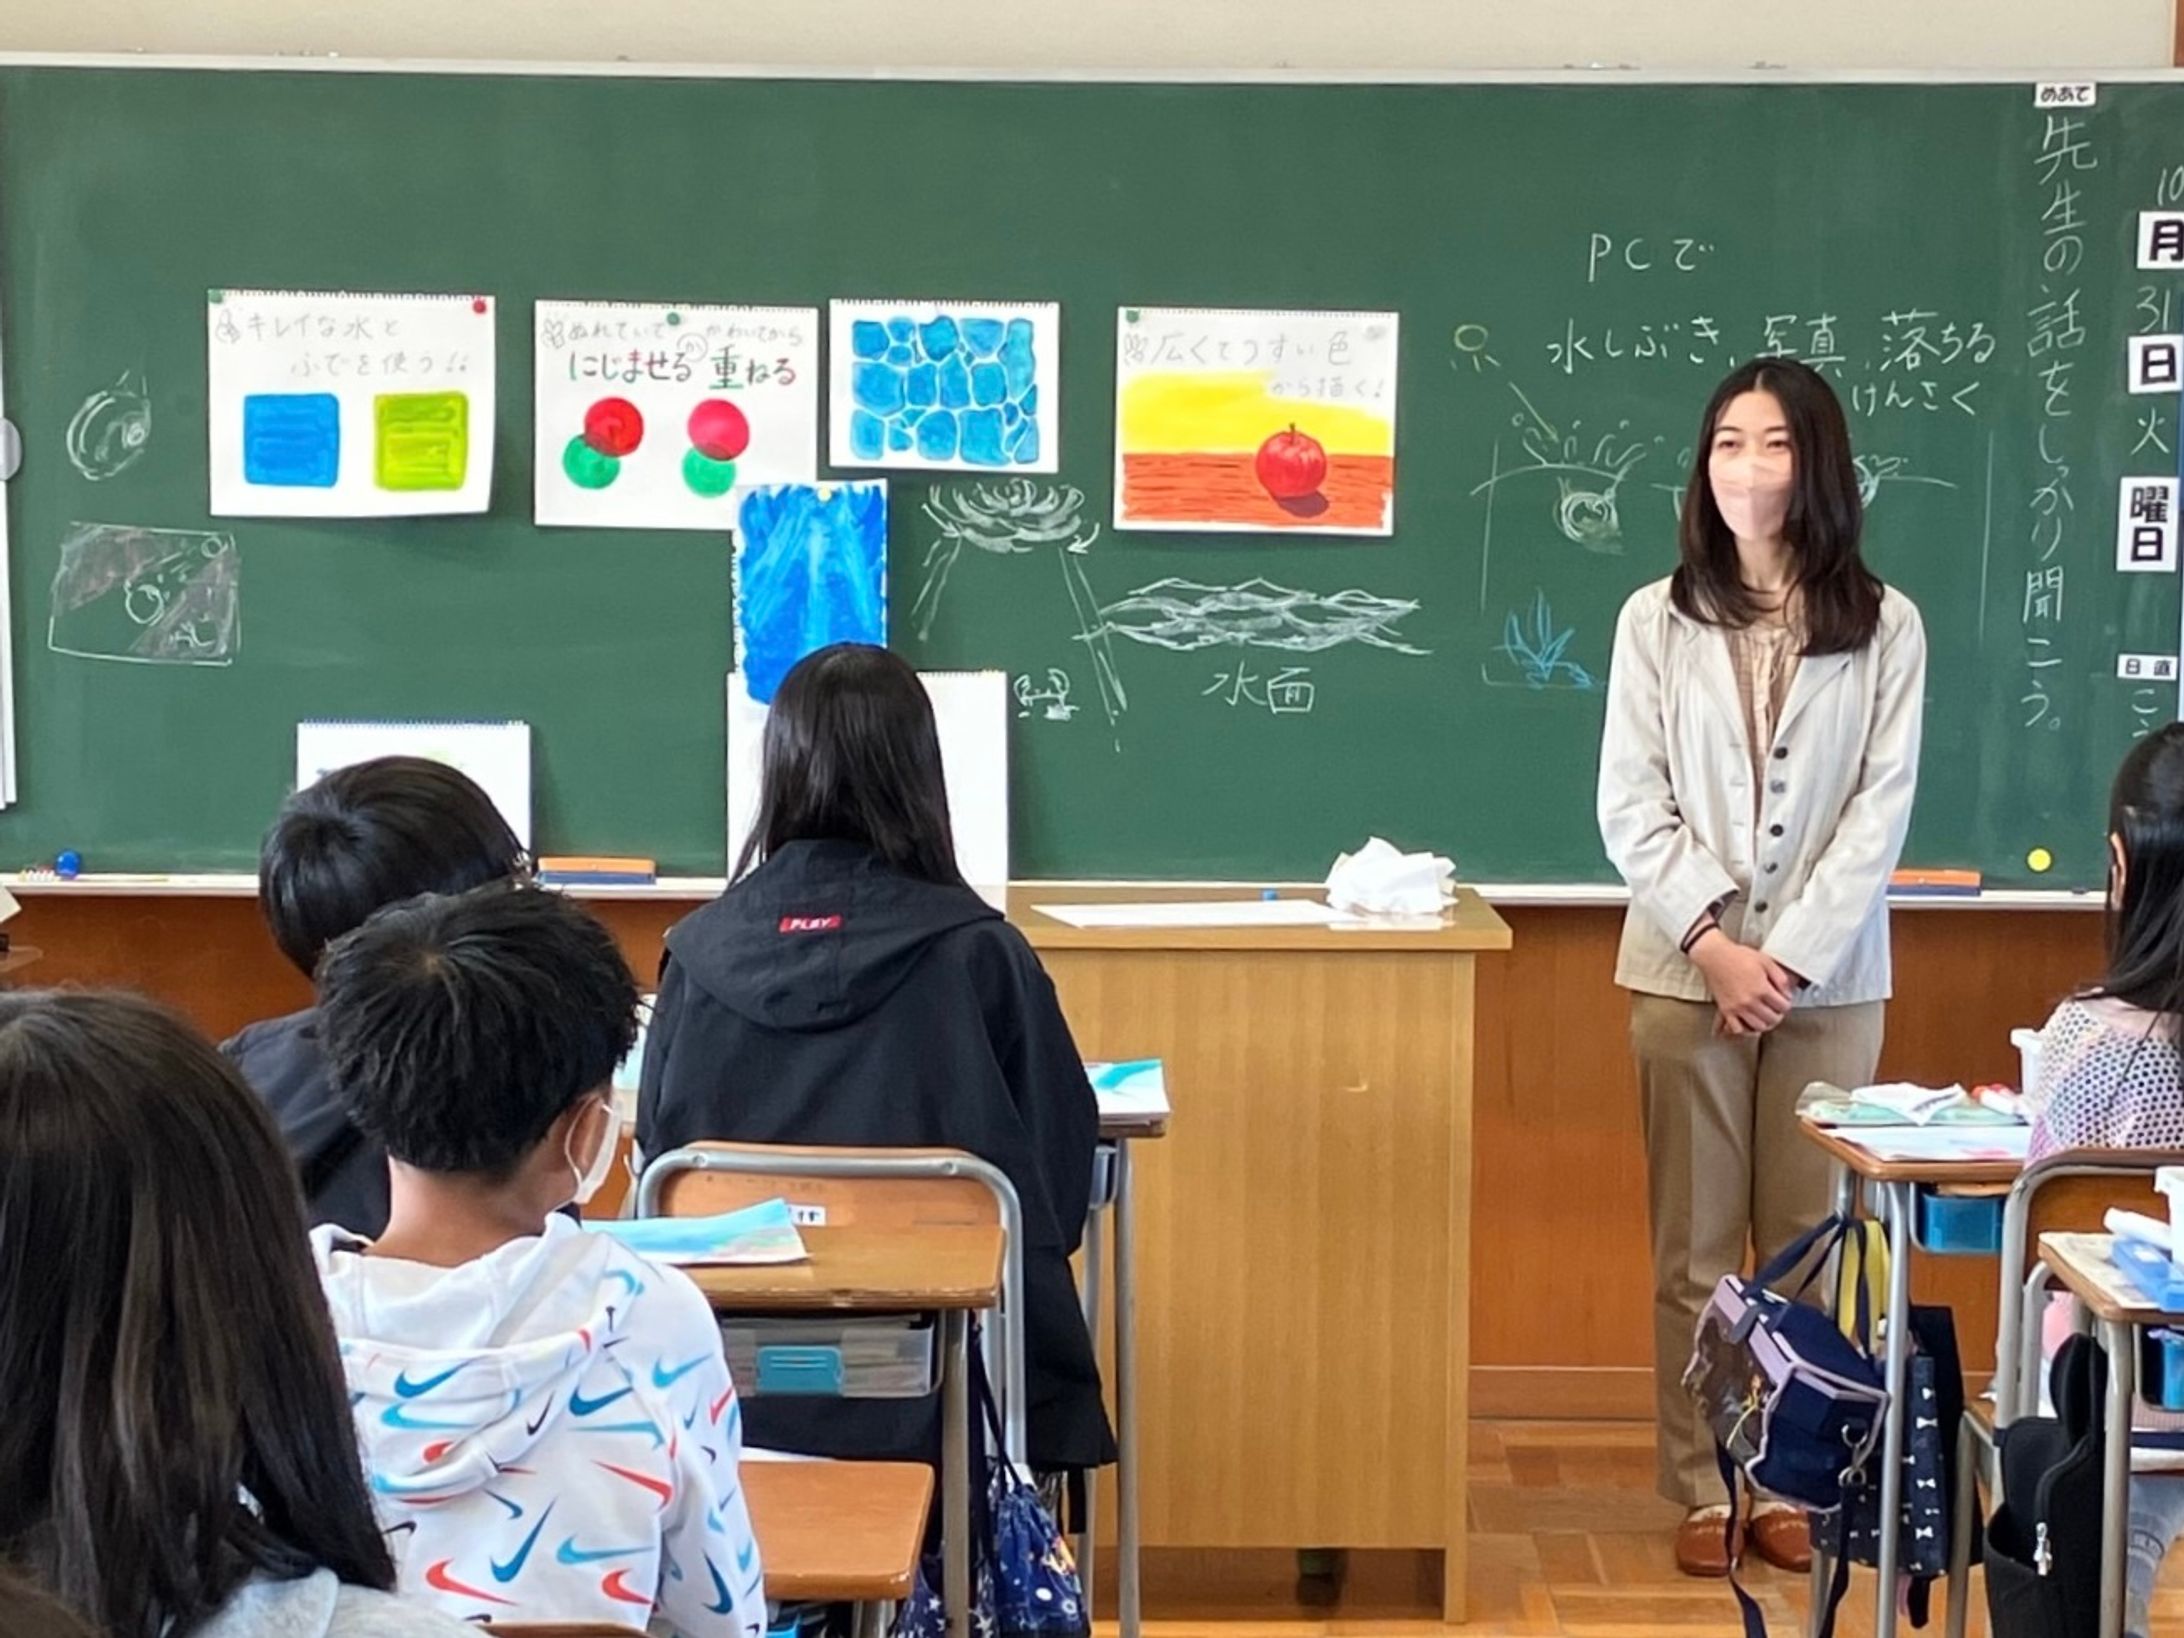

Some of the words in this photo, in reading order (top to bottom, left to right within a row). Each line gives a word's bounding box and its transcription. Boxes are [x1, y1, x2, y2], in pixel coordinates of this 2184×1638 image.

[2040, 85, 2091, 103] めあて
[568, 349, 693, 384] にじませる
[708, 344, 797, 390] 重ねる
[1851, 380, 1980, 417] けんさく
[2129, 485, 2170, 563] 曜日
[1201, 660, 1315, 714] 水面
